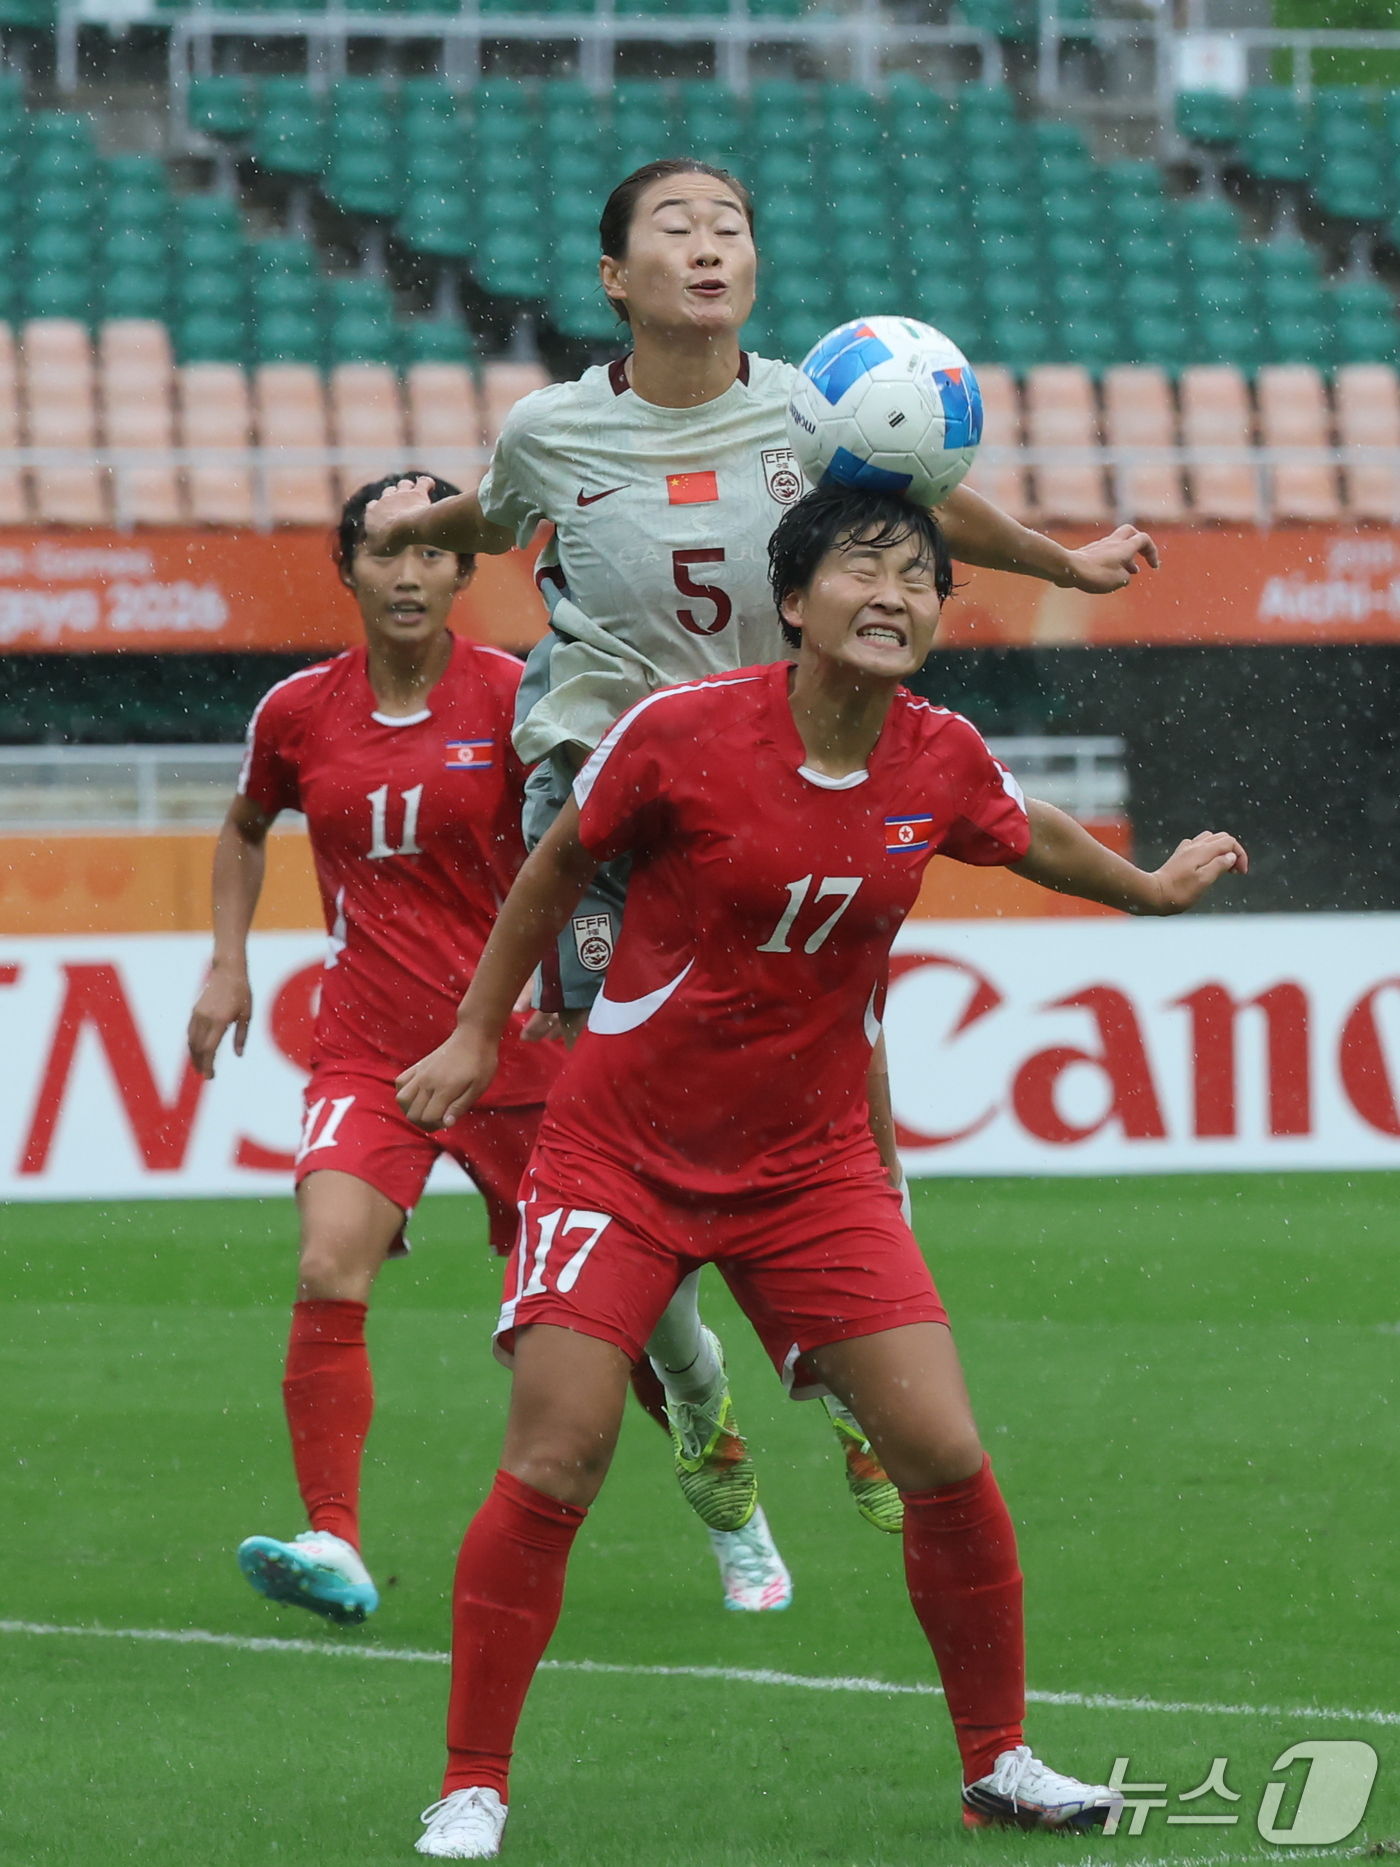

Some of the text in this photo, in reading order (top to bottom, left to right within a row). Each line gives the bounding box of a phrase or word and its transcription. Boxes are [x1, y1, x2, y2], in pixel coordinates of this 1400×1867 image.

[672, 547, 732, 635] 5
[1258, 573, 1400, 624] Aichi-
[366, 783, 424, 860] 11
[575, 916, 608, 931] CFA
[756, 873, 864, 955] 17
[295, 1094, 356, 1165] 11
[521, 1207, 613, 1297] 17
